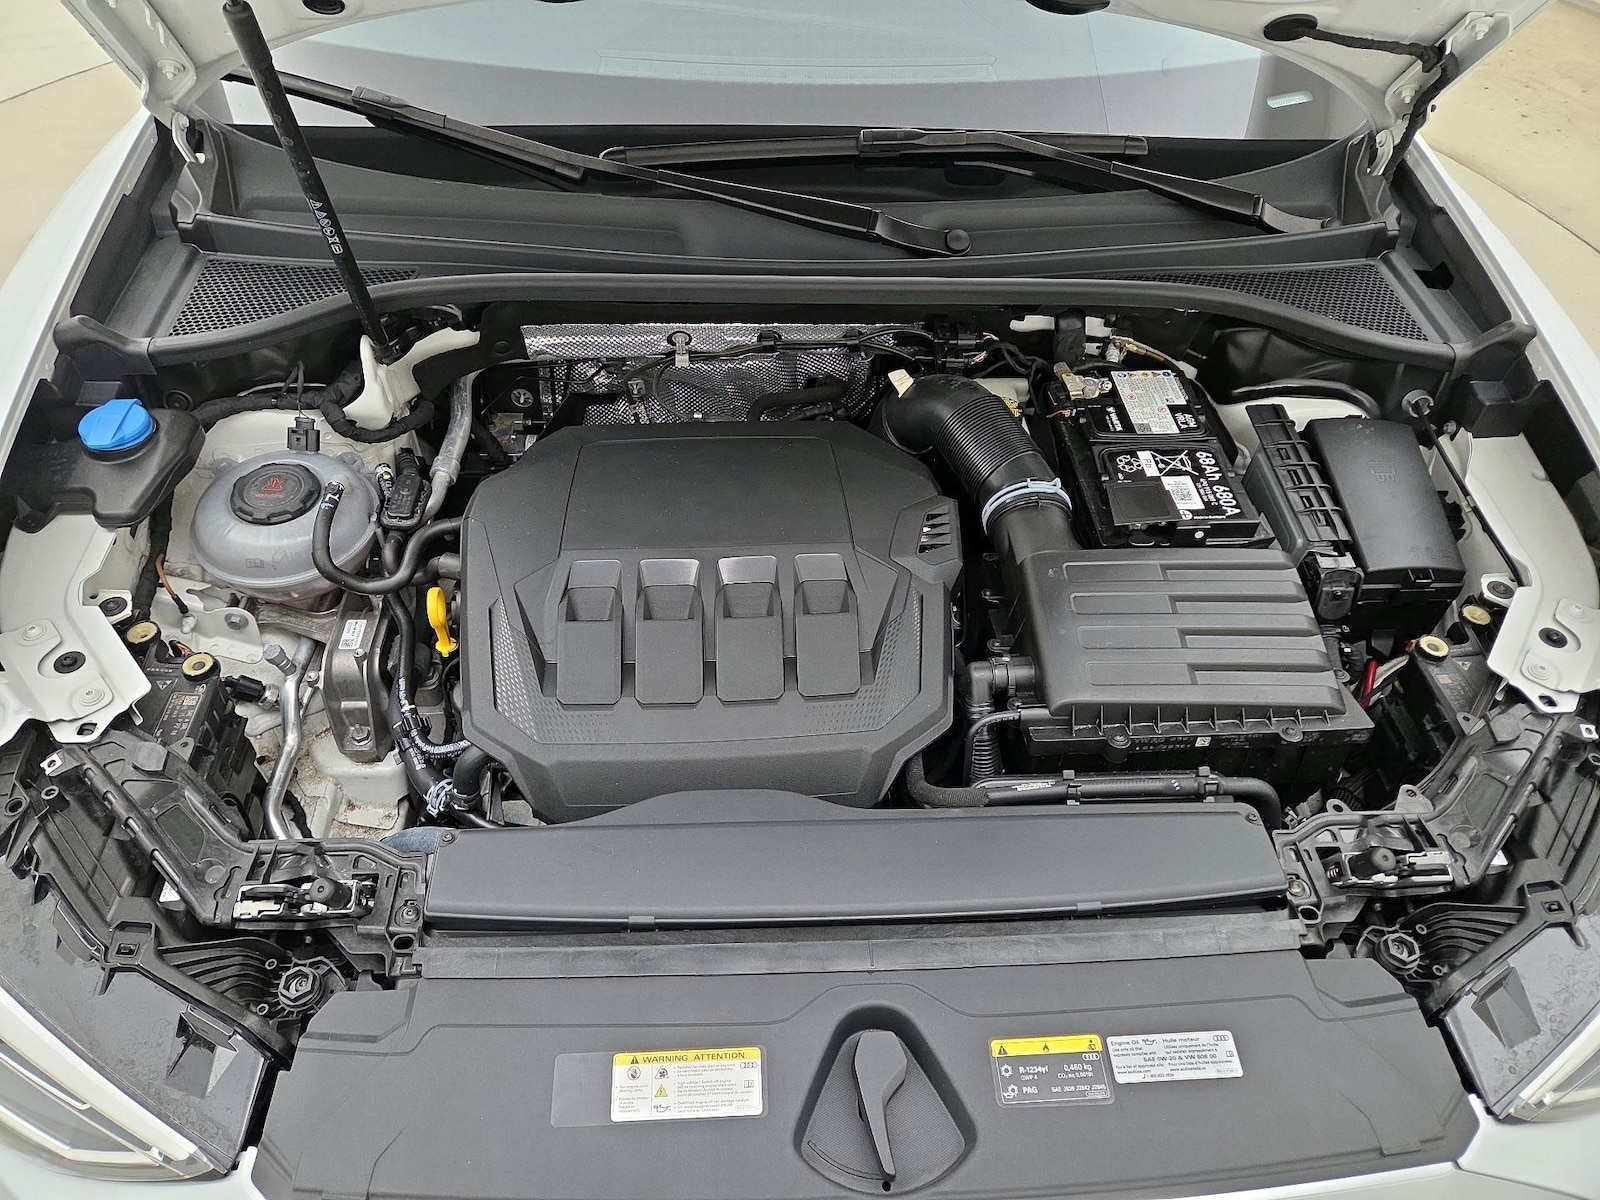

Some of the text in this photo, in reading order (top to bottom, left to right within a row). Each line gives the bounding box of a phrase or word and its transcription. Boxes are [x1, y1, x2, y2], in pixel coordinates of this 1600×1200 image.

[1174, 412, 1188, 429] VRLA
[1183, 413, 1198, 428] AGM
[1142, 458, 1152, 468] Pb
[1196, 451, 1222, 480] 68Ah
[1212, 485, 1241, 516] 680A
[642, 1052, 745, 1063] WARNING ATTENTION
[1019, 1065, 1048, 1074] R-1234yf
